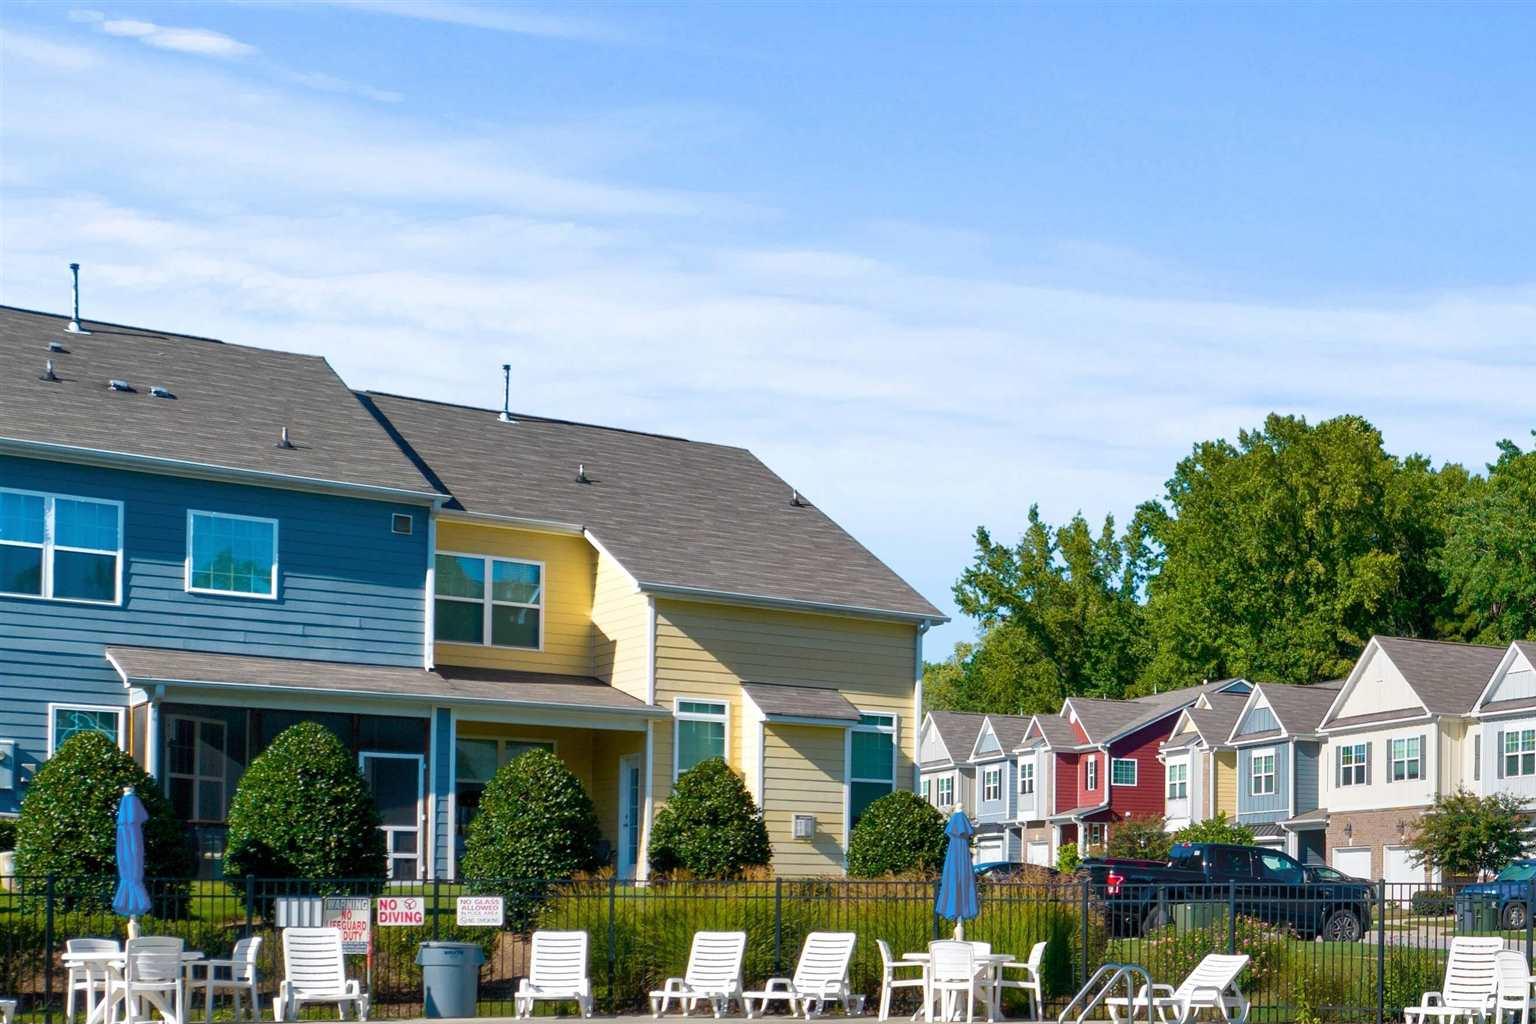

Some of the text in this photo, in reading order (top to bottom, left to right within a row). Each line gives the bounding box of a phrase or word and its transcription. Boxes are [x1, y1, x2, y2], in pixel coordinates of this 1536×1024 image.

[380, 899, 397, 910] NO
[341, 910, 352, 920] NO
[379, 911, 422, 924] DIVING
[343, 931, 363, 940] DUTY
